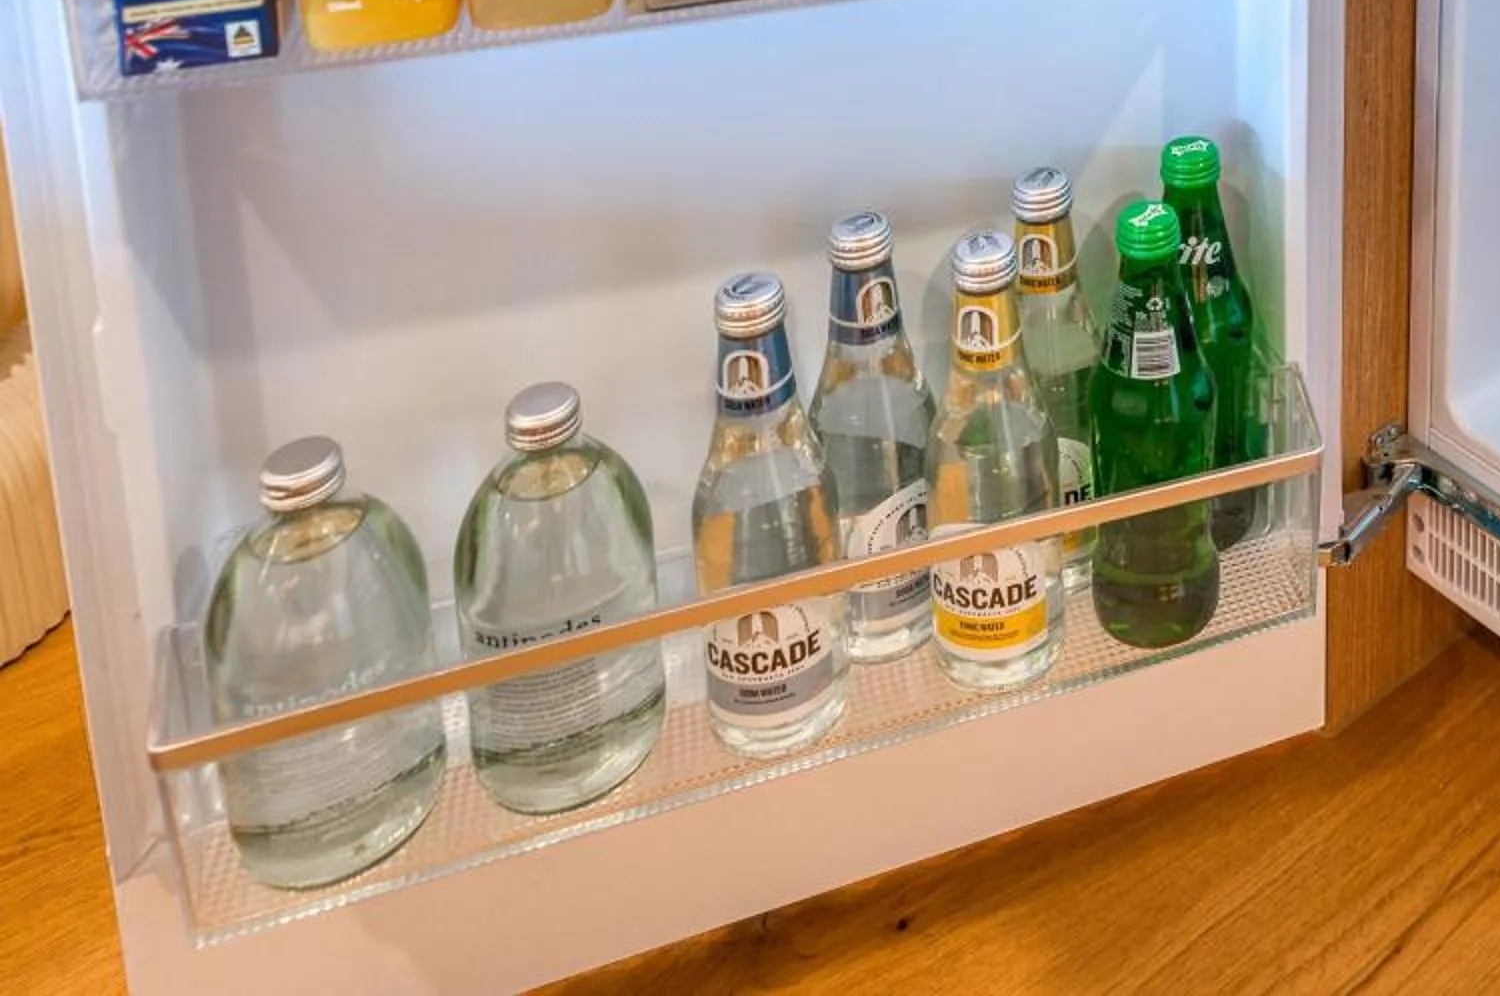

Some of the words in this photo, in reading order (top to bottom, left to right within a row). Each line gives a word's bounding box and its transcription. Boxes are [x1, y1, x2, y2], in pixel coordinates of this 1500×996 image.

[1178, 235, 1223, 265] rite
[932, 574, 1038, 611] CASCADE
[707, 629, 821, 675] CASCADE
